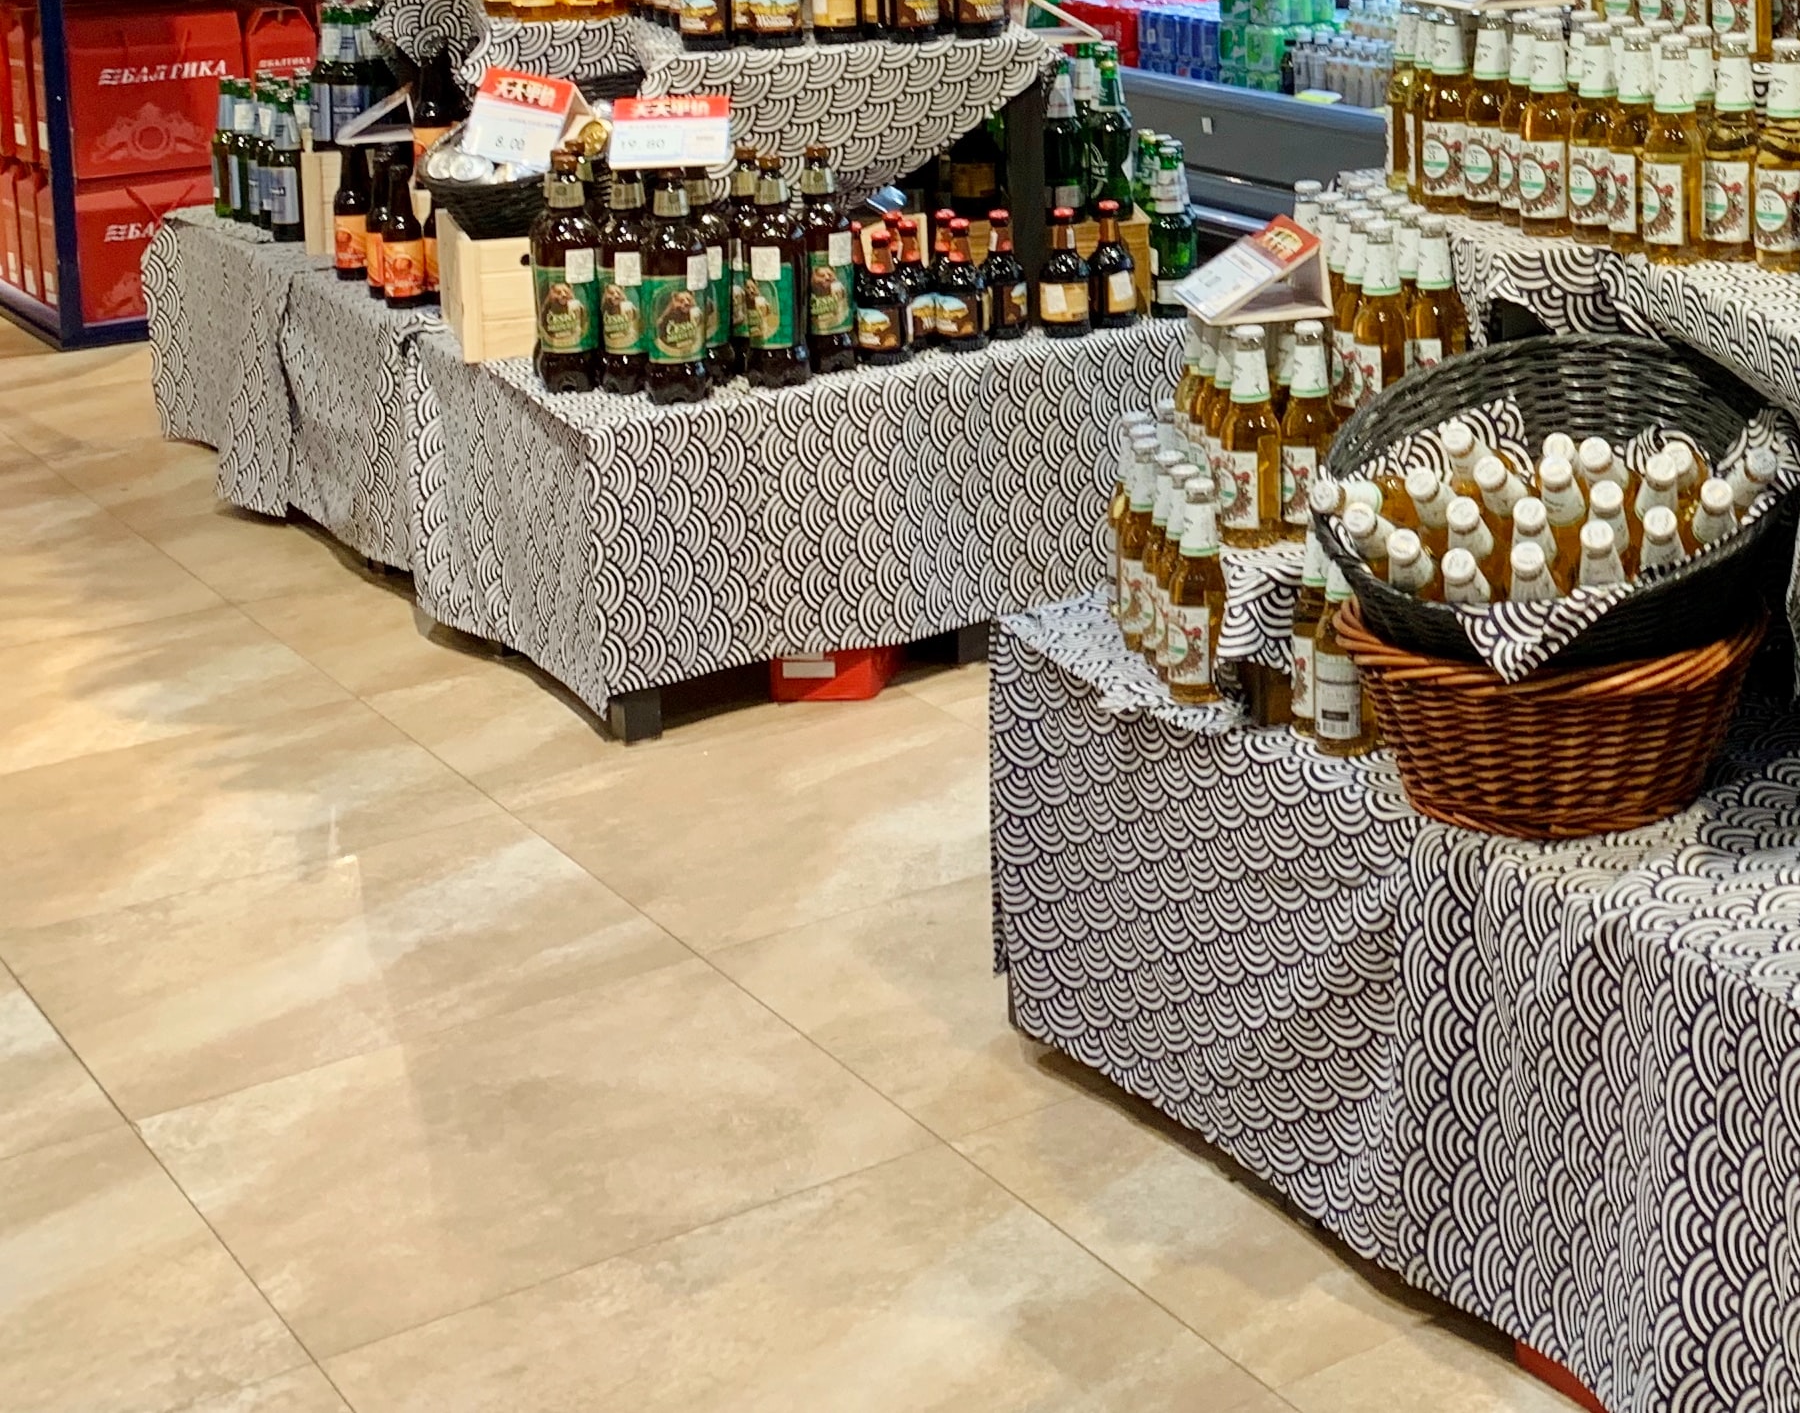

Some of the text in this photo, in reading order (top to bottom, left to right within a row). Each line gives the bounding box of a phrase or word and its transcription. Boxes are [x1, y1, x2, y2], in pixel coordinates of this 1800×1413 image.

[494, 77, 556, 107] 天天平价
[631, 99, 710, 118] 天天平价
